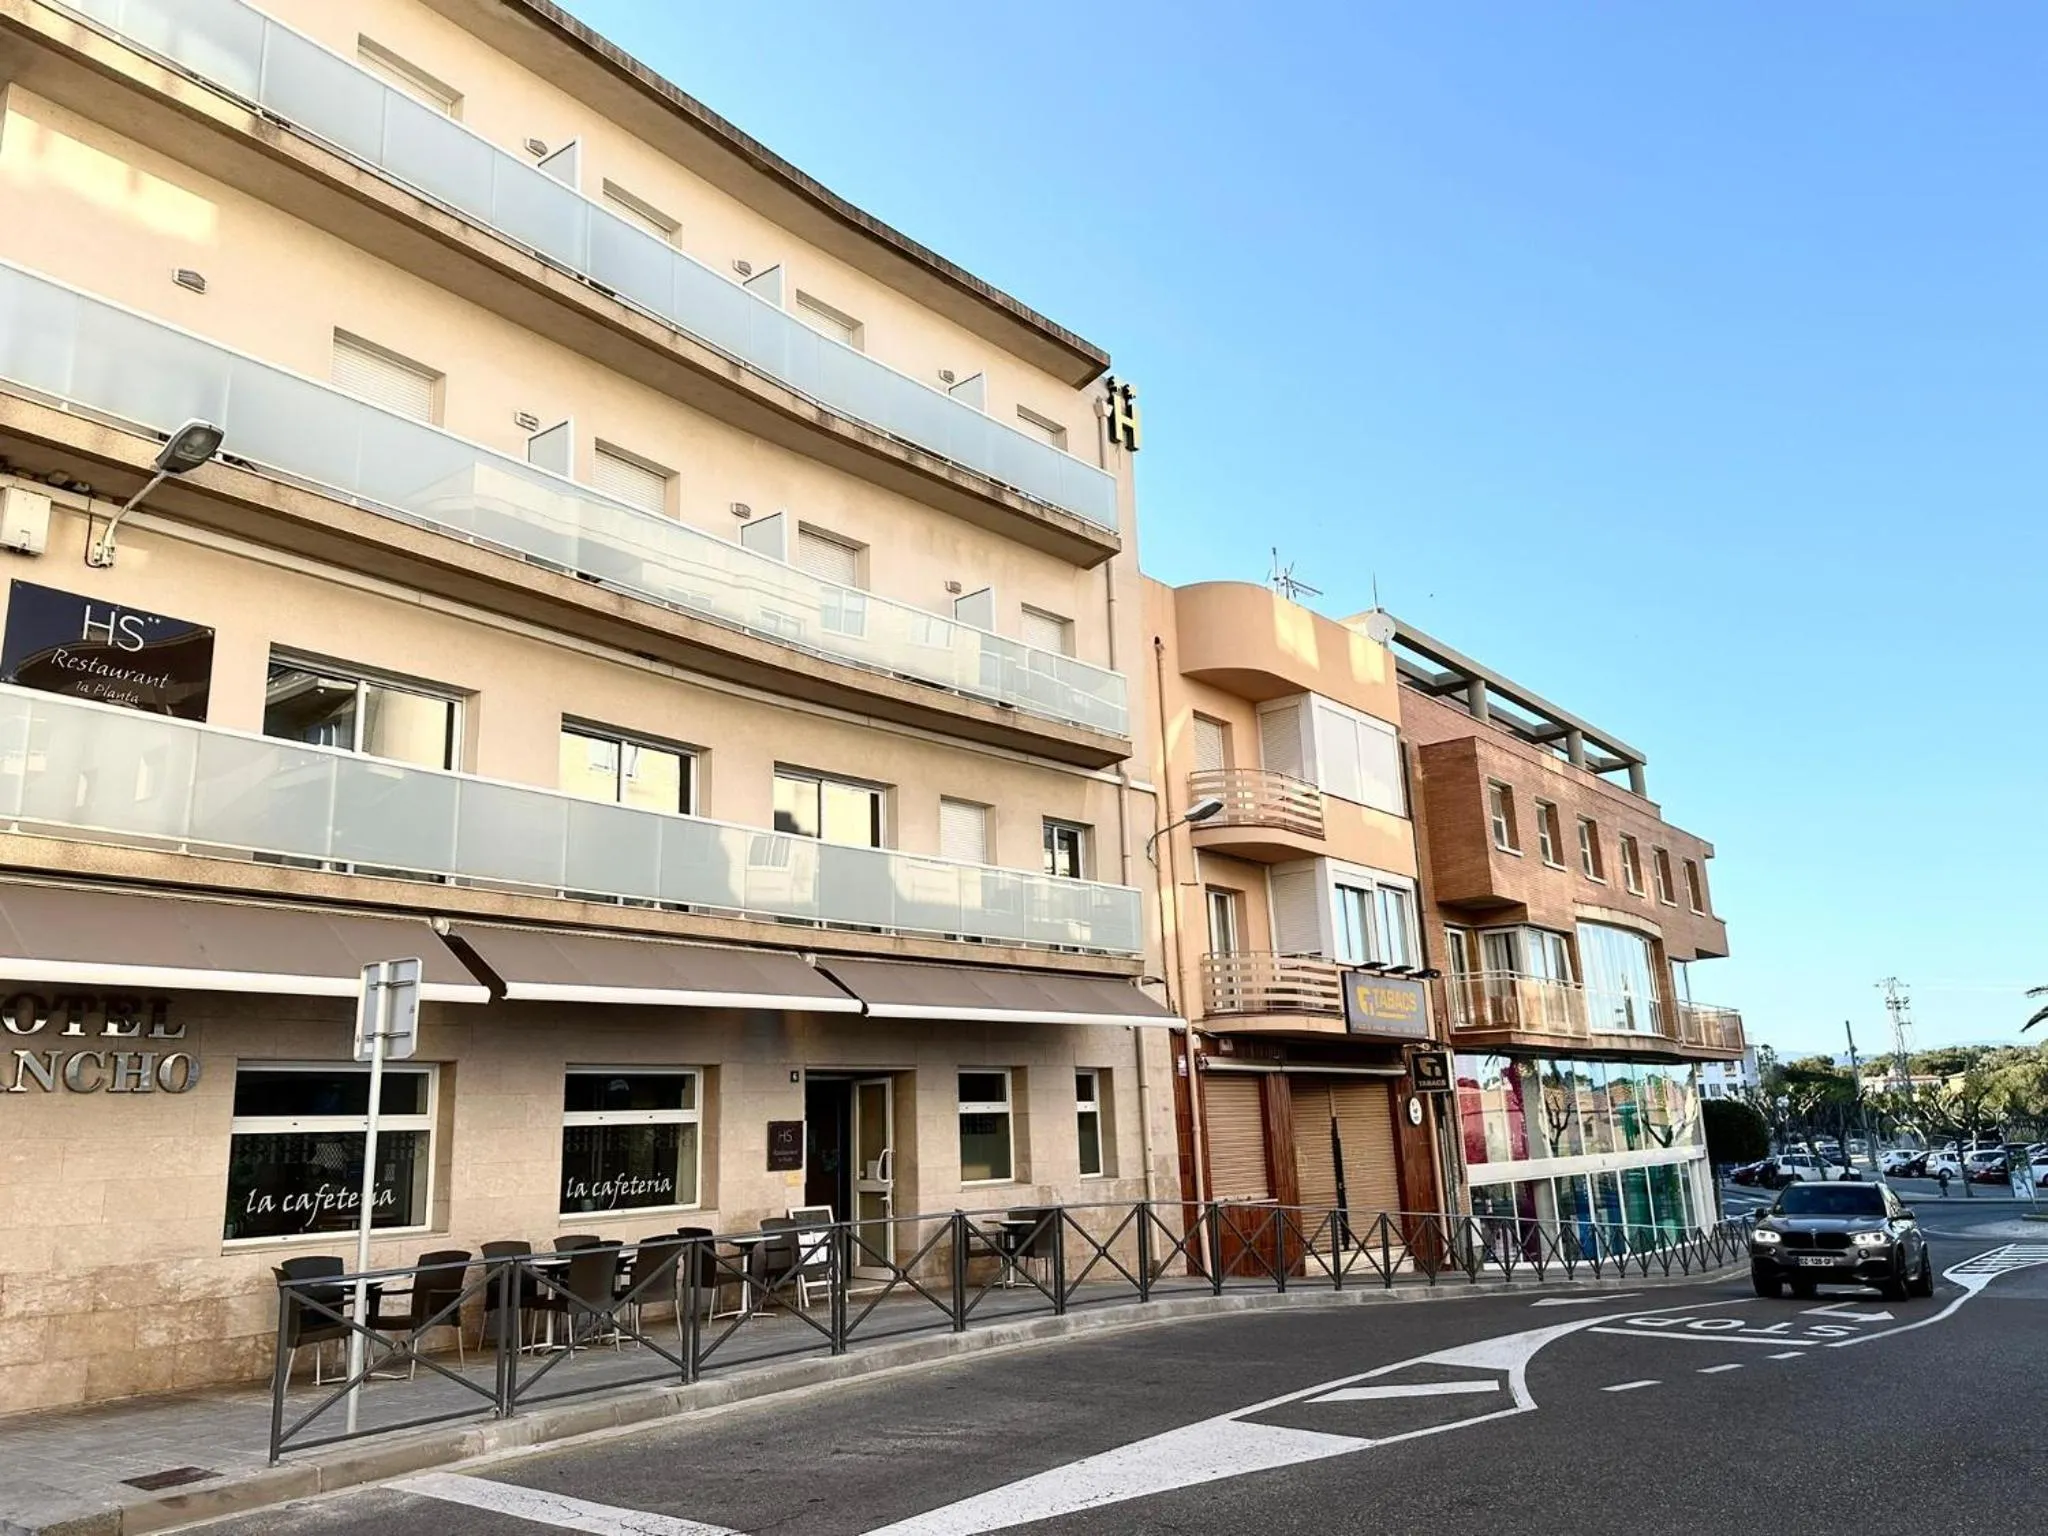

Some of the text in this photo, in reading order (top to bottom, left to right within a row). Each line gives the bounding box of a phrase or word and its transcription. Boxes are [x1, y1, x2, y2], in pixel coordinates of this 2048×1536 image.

[83, 604, 145, 652] HS
[51, 648, 169, 689] Restaurant
[93, 682, 140, 704] Planta
[0, 1050, 200, 1093] NCHO
[246, 1182, 396, 1228] la cafeteia
[566, 1171, 673, 1210] la cafeteria
[1625, 1316, 1862, 1337] STOP
